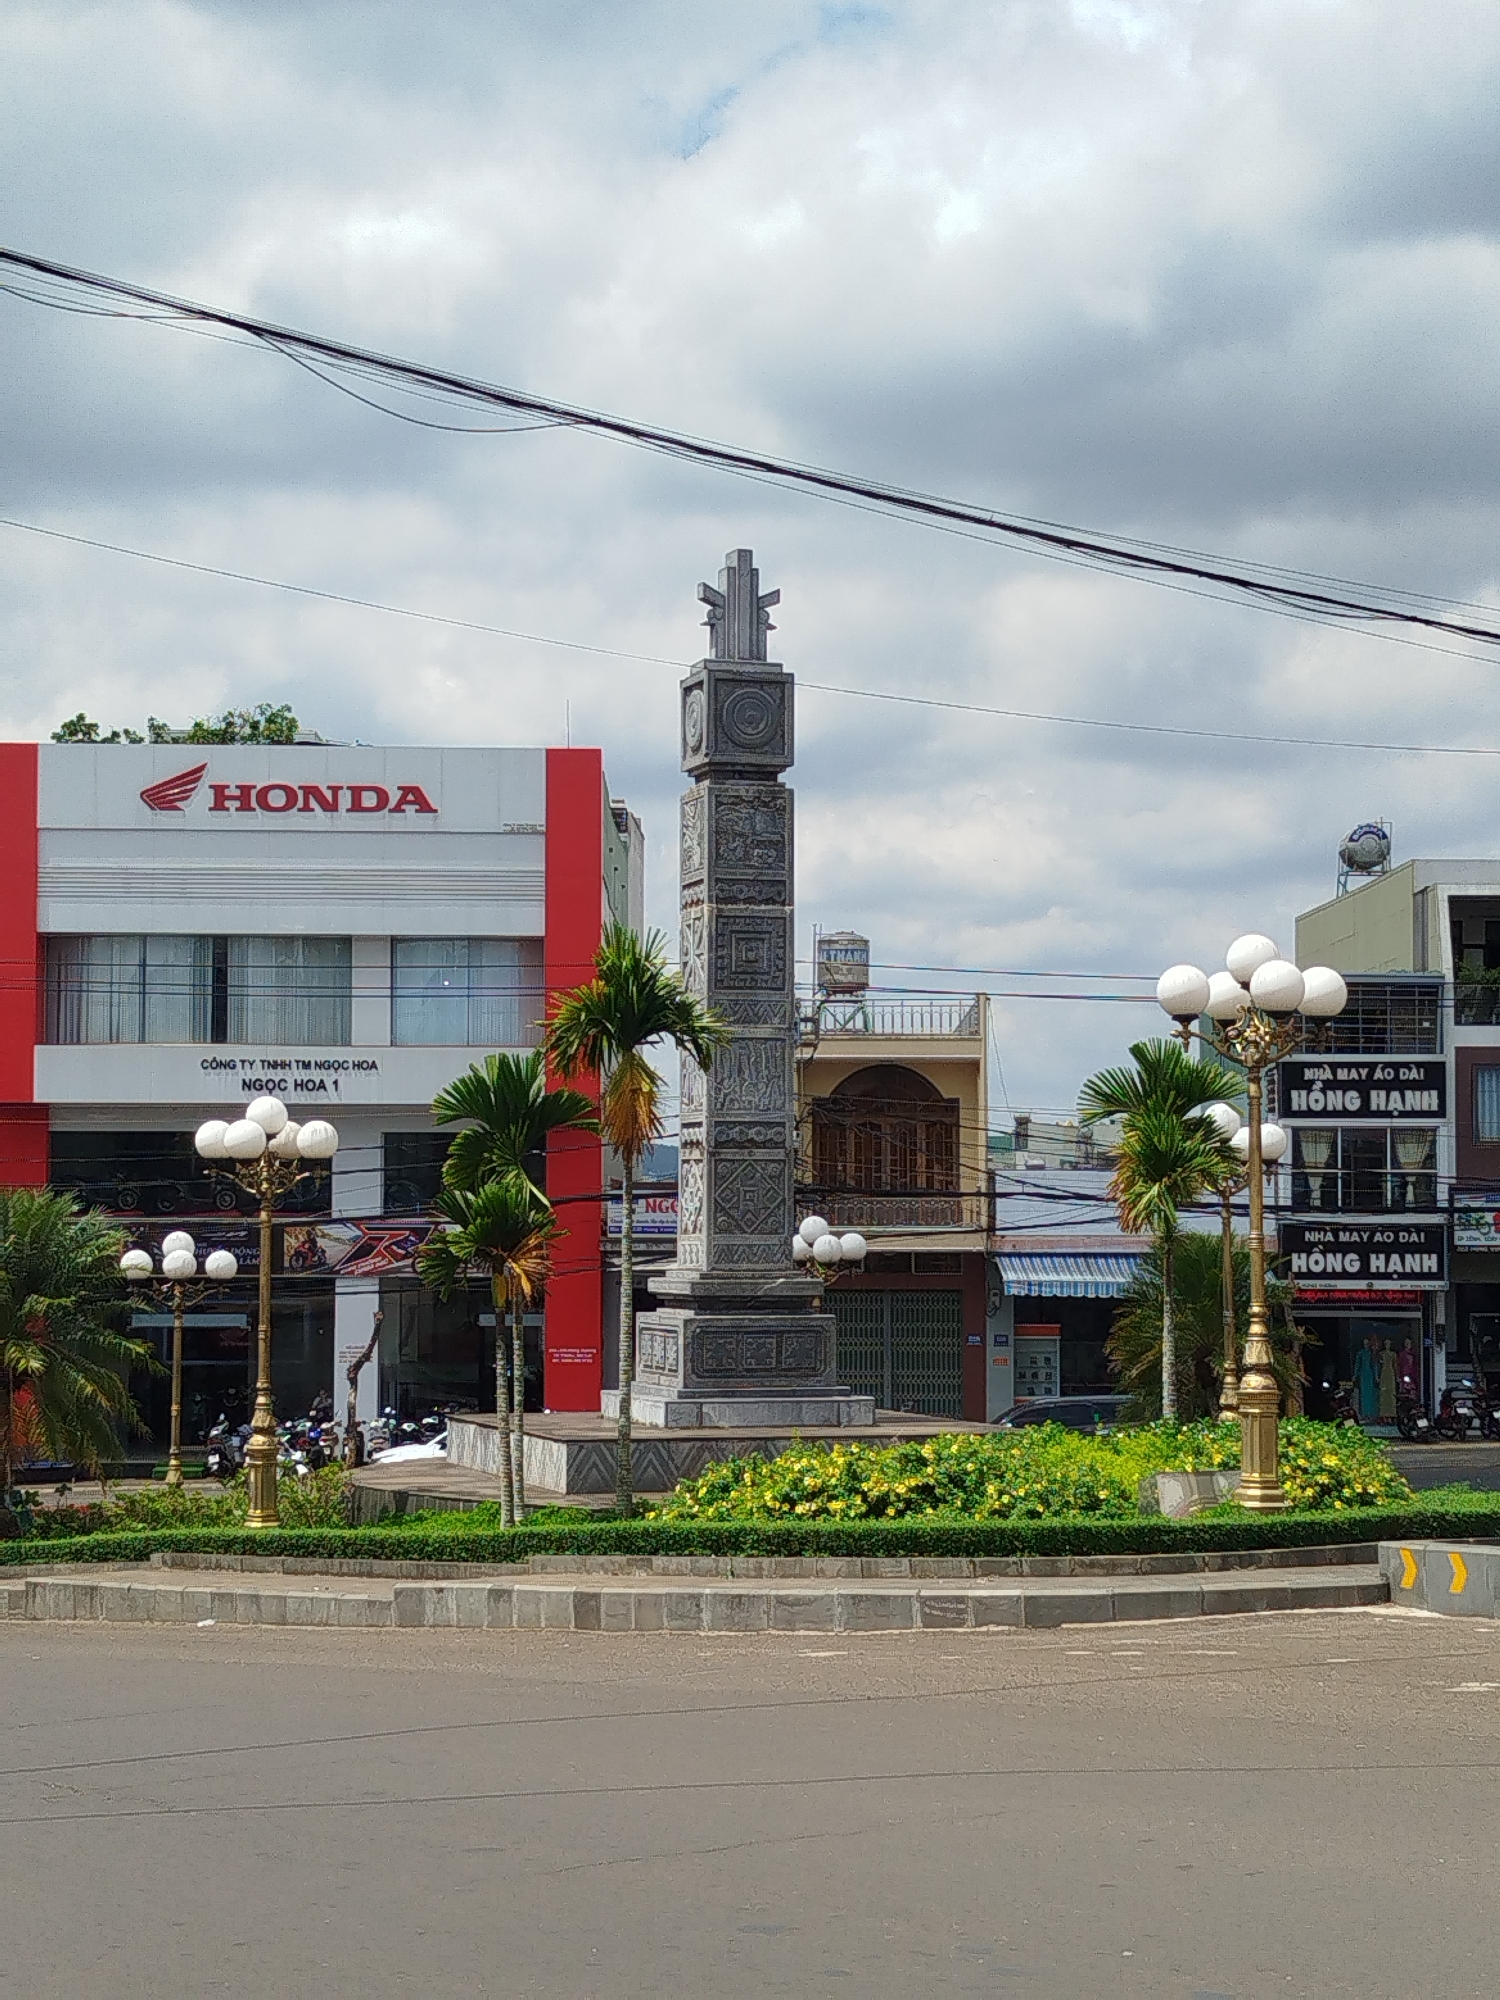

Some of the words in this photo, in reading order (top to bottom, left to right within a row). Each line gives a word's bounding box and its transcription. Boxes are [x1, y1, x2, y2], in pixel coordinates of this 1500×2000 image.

[208, 784, 438, 813] HONDA
[201, 1057, 237, 1070] CÔNG
[239, 1059, 256, 1070] TY
[260, 1059, 292, 1070] TNHH
[294, 1059, 311, 1070] TM
[314, 1059, 350, 1073] NGỌC
[352, 1059, 378, 1070] HOA
[1304, 1064, 1333, 1080] NHÀ
[1337, 1068, 1369, 1080] MAY
[1373, 1064, 1394, 1080] ÁO
[1399, 1064, 1425, 1080] DÀI
[242, 1078, 288, 1094] NGỌC
[294, 1078, 327, 1092] HOA
[332, 1078, 338, 1092] 1
[1291, 1081, 1361, 1111] HỒNG
[1369, 1090, 1439, 1116] HẠNH
[1305, 1228, 1334, 1242] NHÀ
[1338, 1231, 1369, 1242] MAY
[1399, 1228, 1425, 1243] DÀI
[1292, 1245, 1361, 1273] HỒNG
[1369, 1253, 1438, 1279] HẠNH
